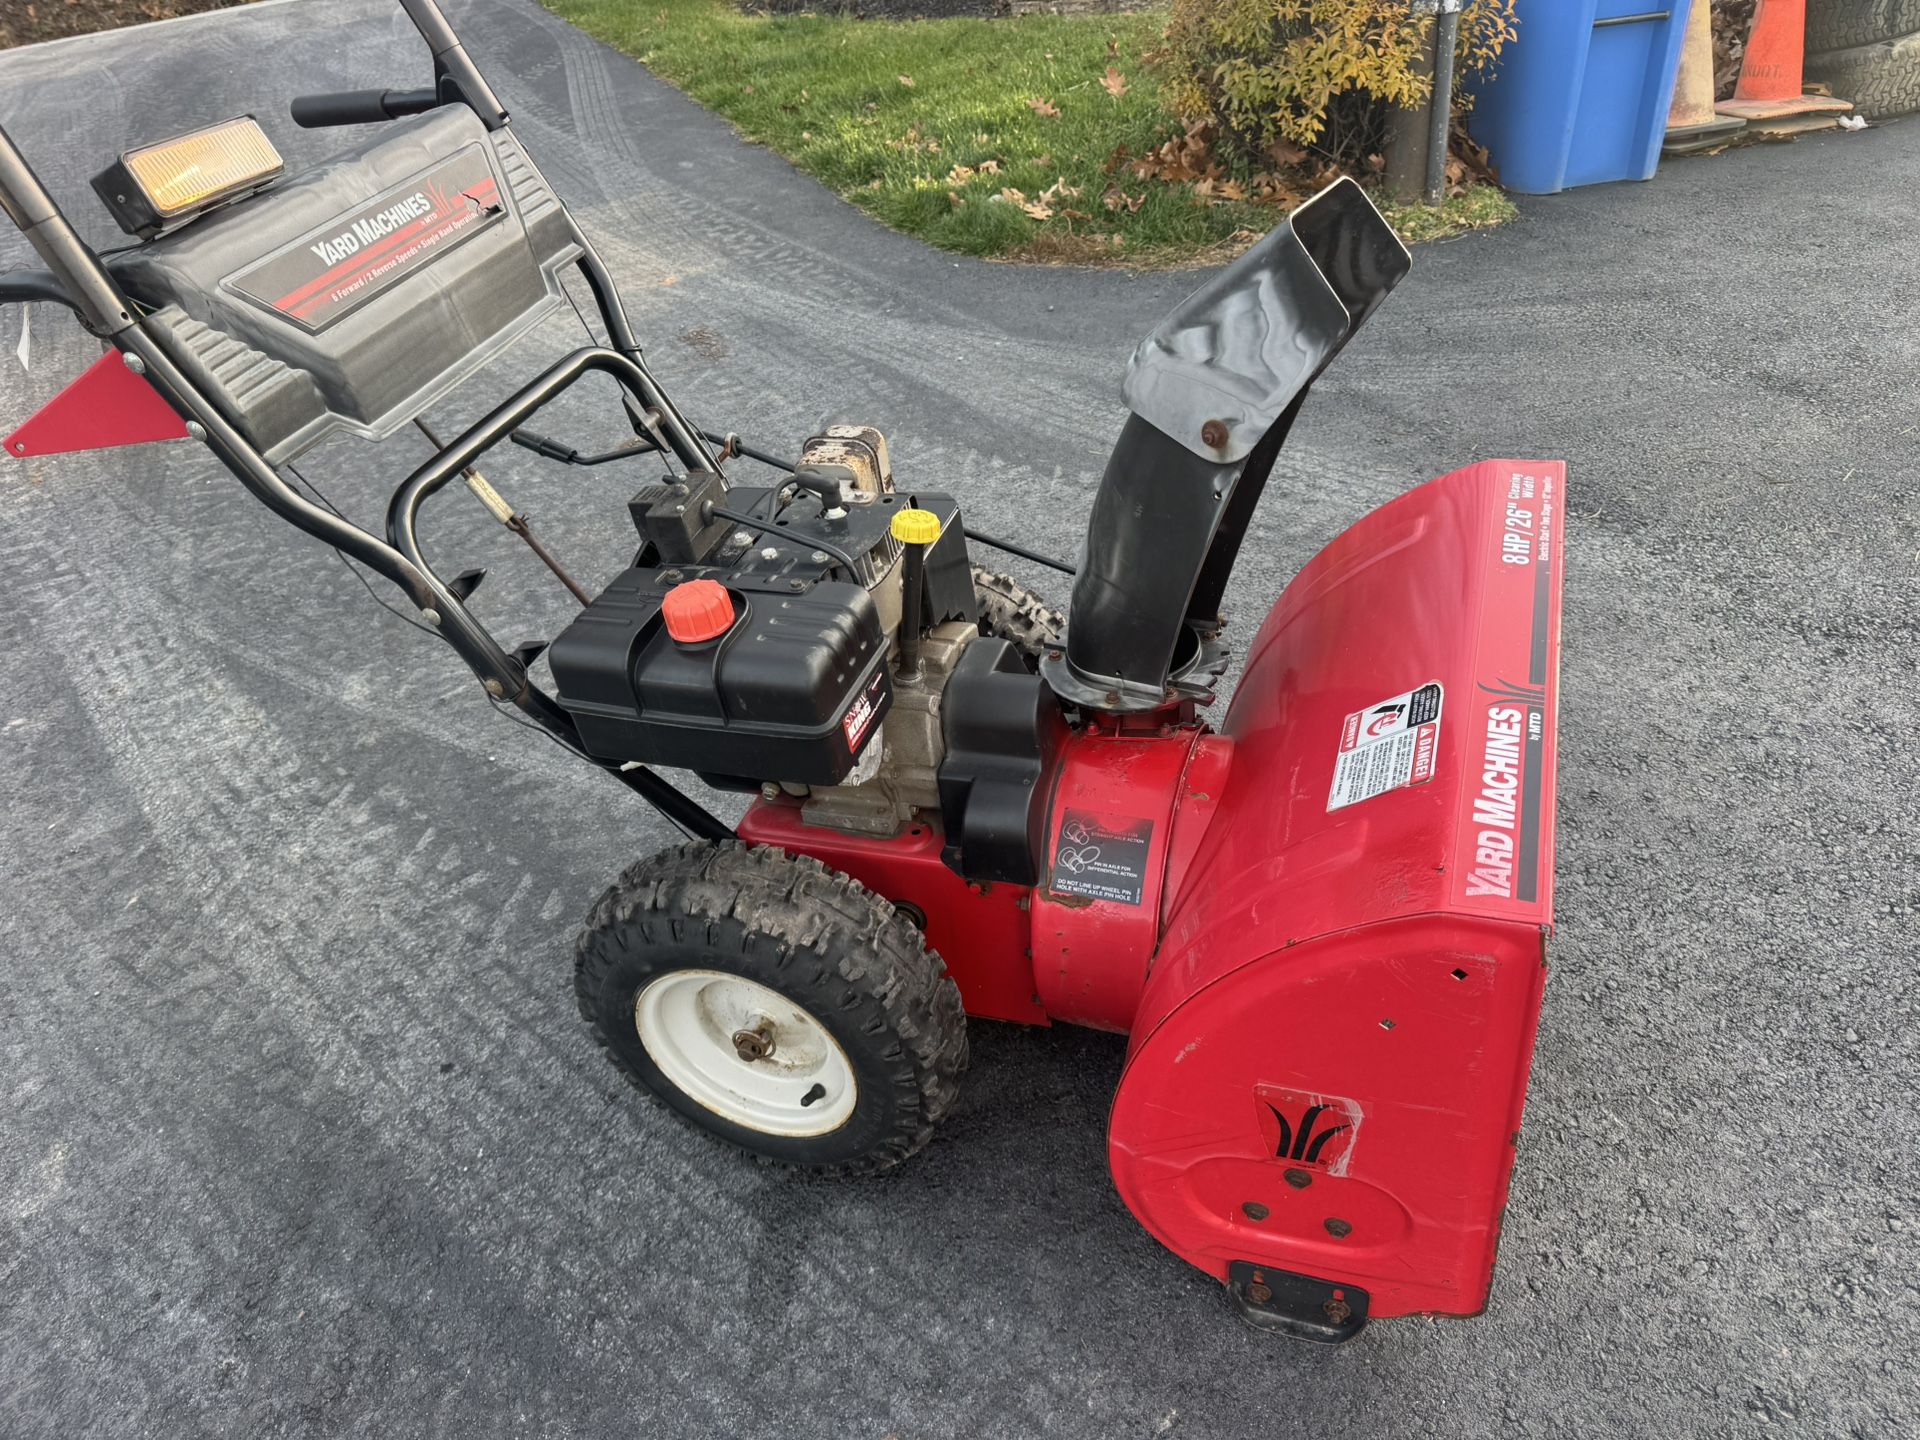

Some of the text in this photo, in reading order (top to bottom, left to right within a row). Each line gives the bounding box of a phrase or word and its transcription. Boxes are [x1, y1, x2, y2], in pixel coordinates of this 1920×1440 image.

[311, 192, 431, 267] YARD MACHINES
[423, 212, 438, 225] MTD
[337, 277, 364, 298] Forward
[366, 272, 374, 282] 2
[373, 259, 398, 278] Reverse
[395, 247, 419, 266] Speeds
[420, 233, 440, 249] Single
[438, 223, 454, 238] Hand
[1507, 473, 1523, 499] Clearing
[1522, 475, 1534, 498] Width
[1529, 712, 1541, 741] by MTD
[1465, 707, 1523, 898] YARD MACHINES
[1073, 886, 1087, 894] WITH
[1101, 886, 1121, 894] WHEEL
